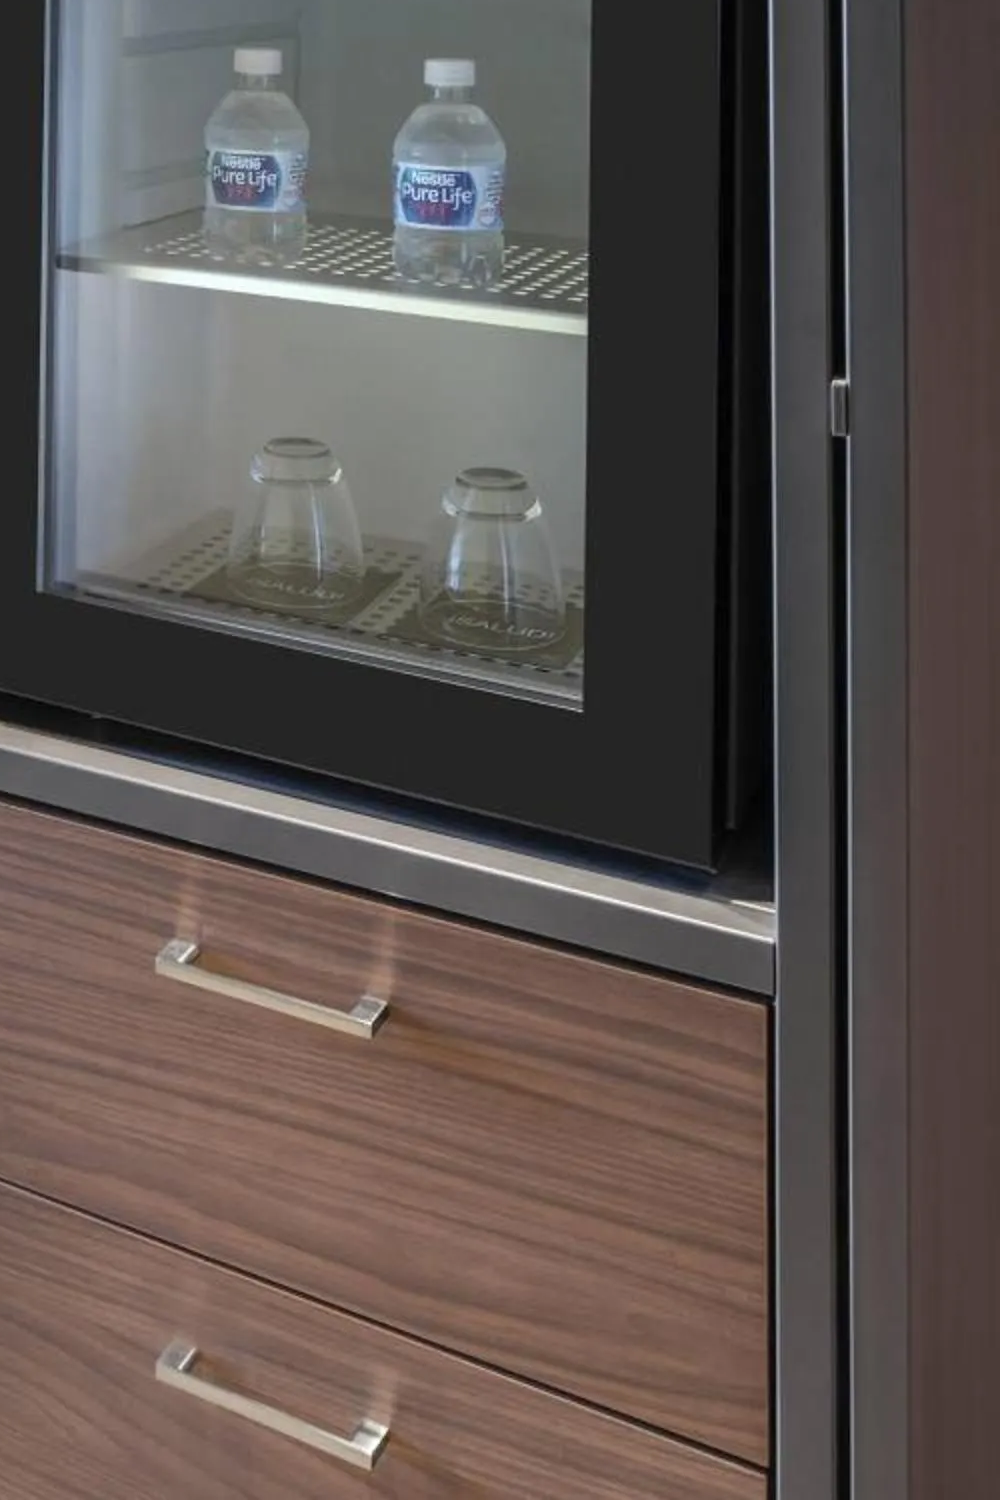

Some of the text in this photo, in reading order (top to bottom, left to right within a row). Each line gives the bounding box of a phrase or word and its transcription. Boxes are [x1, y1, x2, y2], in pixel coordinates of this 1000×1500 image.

[213, 164, 245, 185] Pure
[249, 169, 277, 193] Life
[402, 181, 439, 203] Pure
[441, 187, 473, 211] Life
